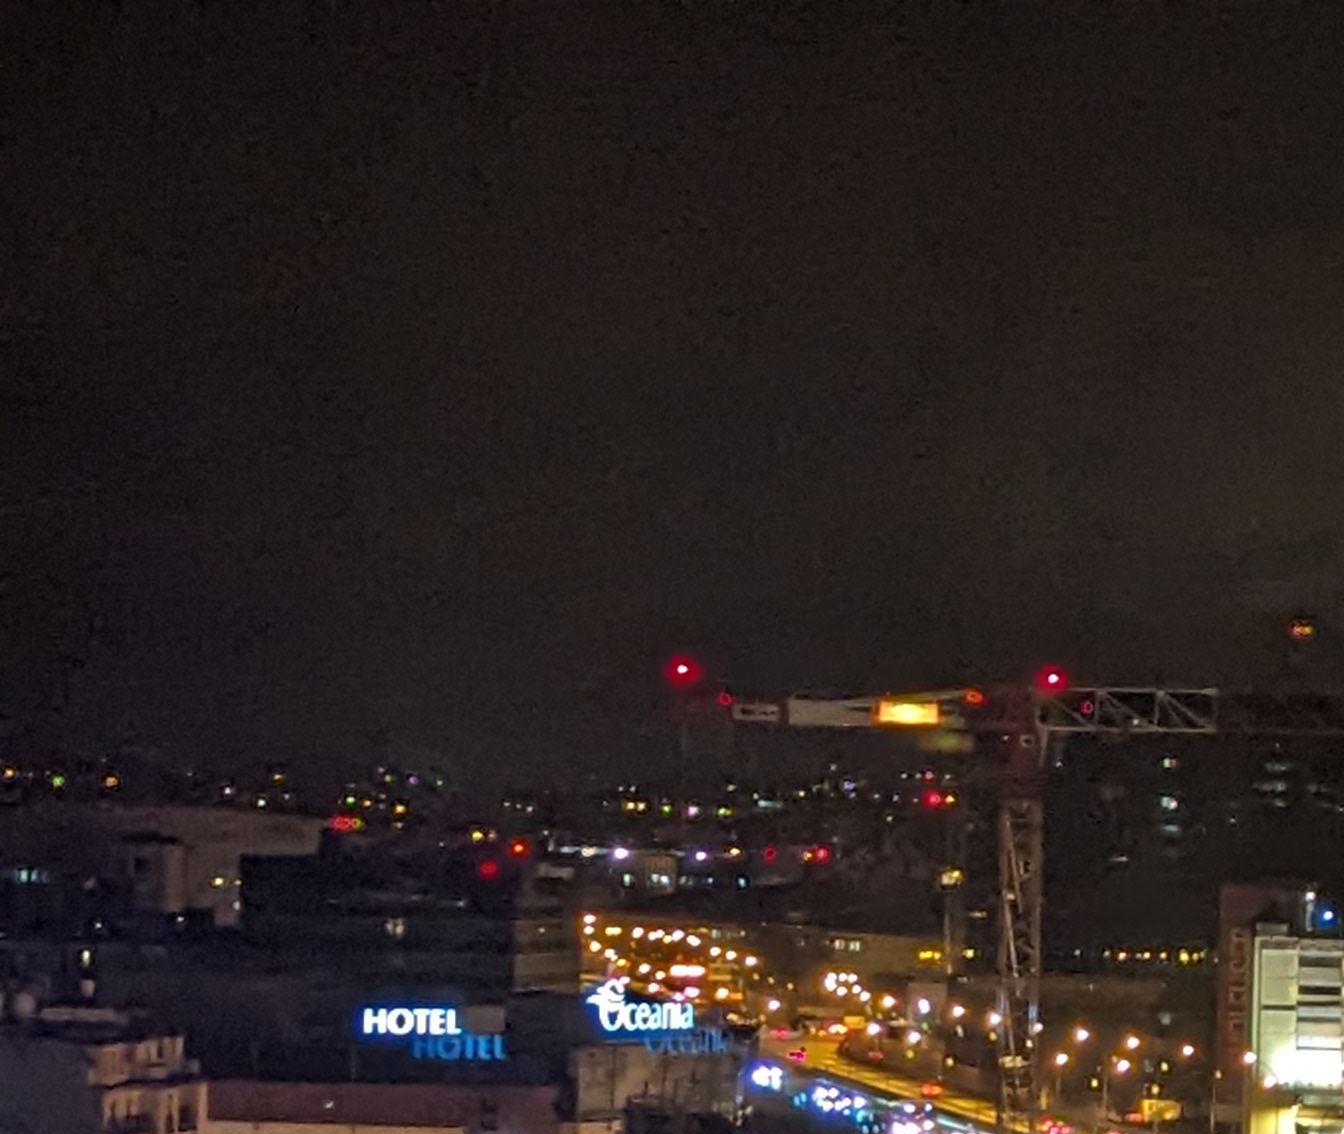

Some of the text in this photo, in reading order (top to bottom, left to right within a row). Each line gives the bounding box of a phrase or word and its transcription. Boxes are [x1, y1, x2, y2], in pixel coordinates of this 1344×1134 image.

[592, 981, 695, 1031] Oceania
[363, 1008, 461, 1034] HOTEL
[412, 1034, 506, 1060] HOTEL
